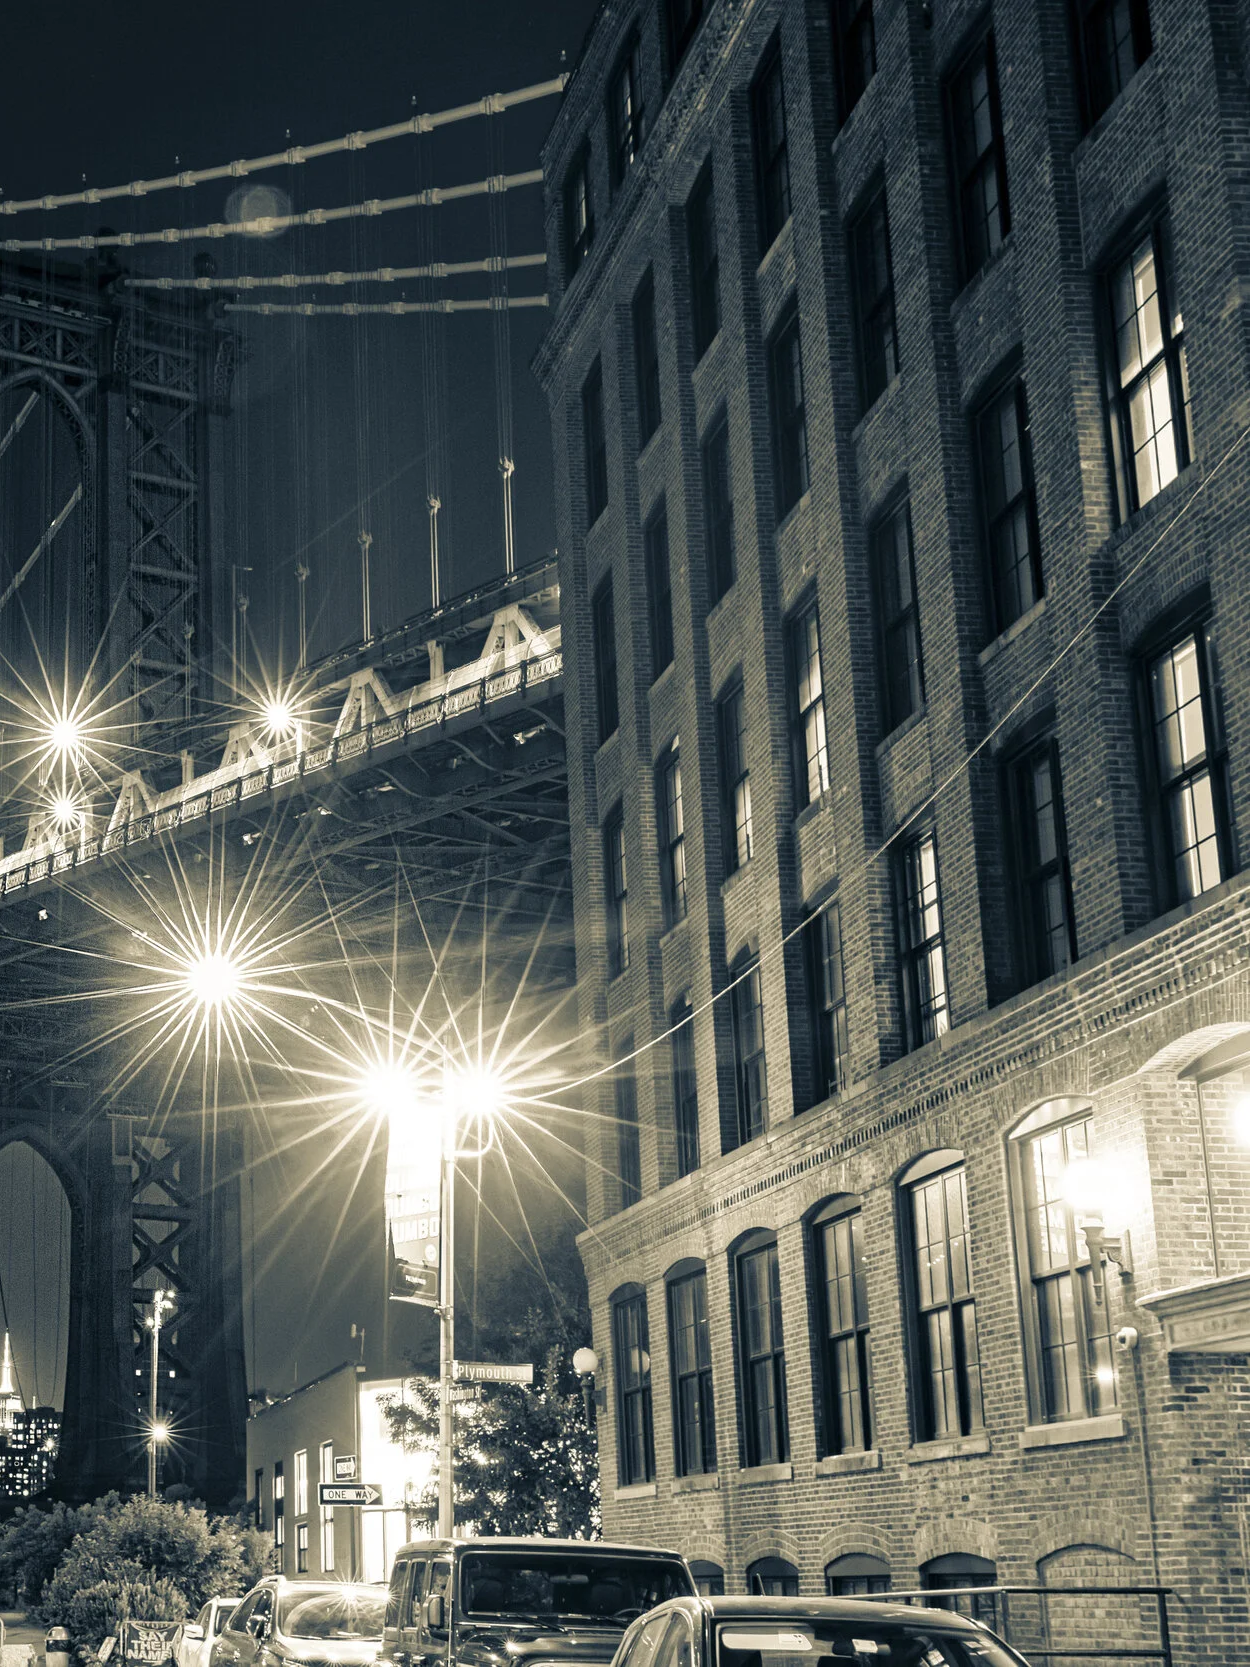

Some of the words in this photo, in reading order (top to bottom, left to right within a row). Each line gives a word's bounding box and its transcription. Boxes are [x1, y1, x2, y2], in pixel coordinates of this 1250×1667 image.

[393, 1217, 440, 1243] UMBO
[458, 1365, 512, 1381] Plymouth
[328, 1490, 347, 1499] ONE
[355, 1490, 374, 1499] WAY
[138, 1631, 168, 1641] SAY
